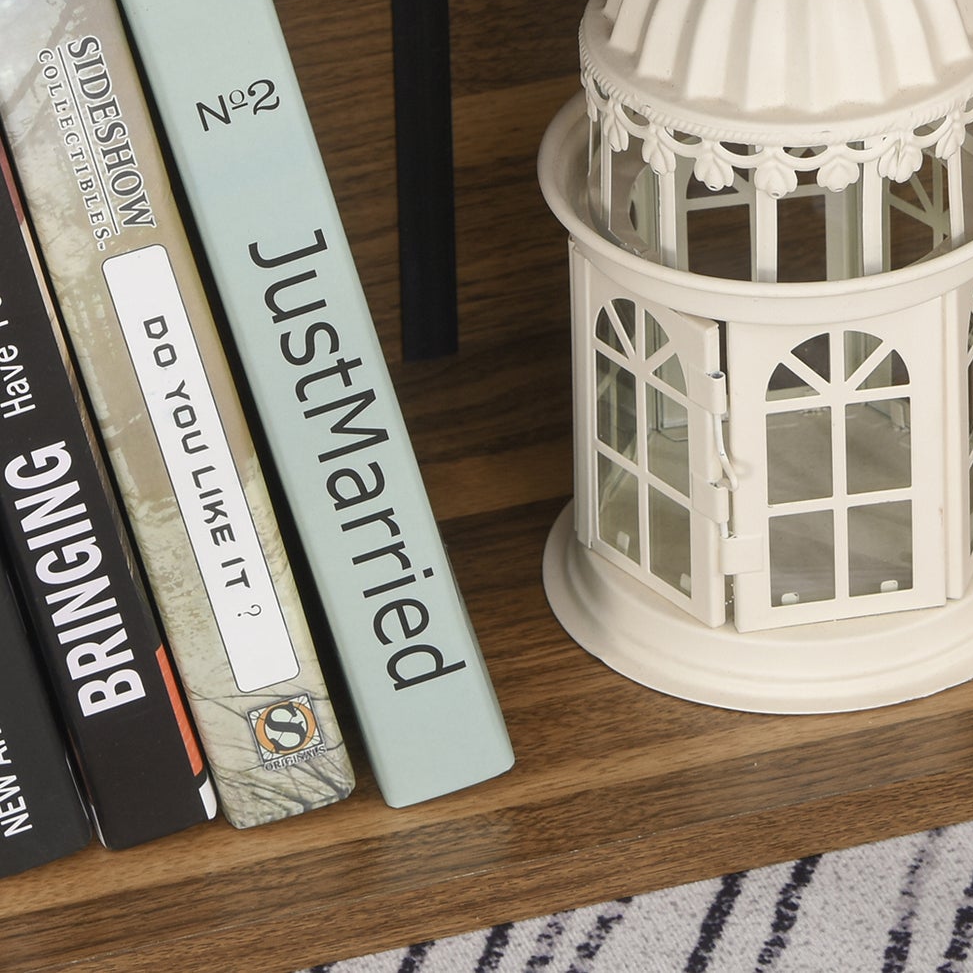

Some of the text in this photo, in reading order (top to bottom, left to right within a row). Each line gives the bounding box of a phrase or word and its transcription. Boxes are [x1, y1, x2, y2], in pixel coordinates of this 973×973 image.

[38, 49, 112, 243] COLLECTIBLES
[67, 35, 156, 228] SIDESHOW
[0, 343, 37, 419] Have
[143, 315, 178, 369] DO
[164, 379, 210, 455] YOU
[191, 465, 236, 547] LIKE
[221, 557, 251, 589] IT
[248, 228, 467, 691] JustMarried
[3, 440, 148, 718] BRINGING
